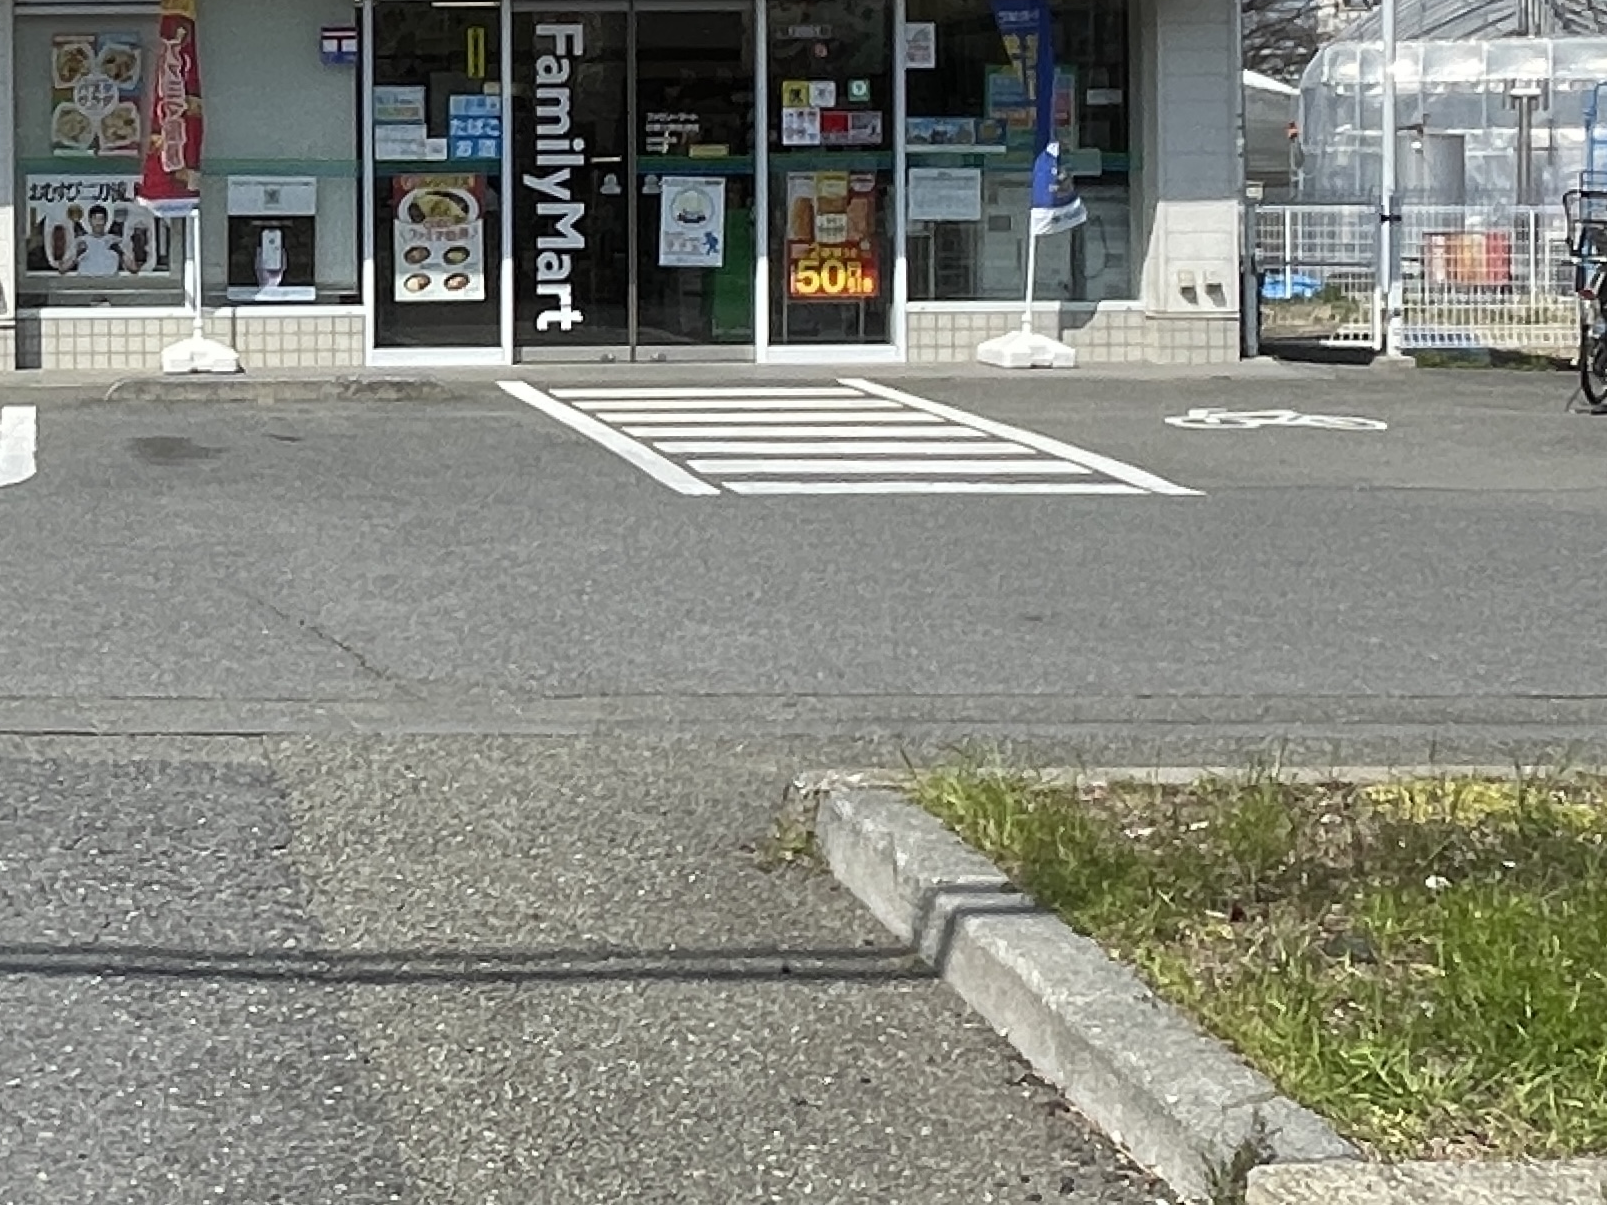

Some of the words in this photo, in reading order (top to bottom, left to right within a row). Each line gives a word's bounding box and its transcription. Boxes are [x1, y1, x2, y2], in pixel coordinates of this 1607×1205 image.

[450, 118, 501, 137] たばこ
[523, 23, 585, 331] FamilyMart
